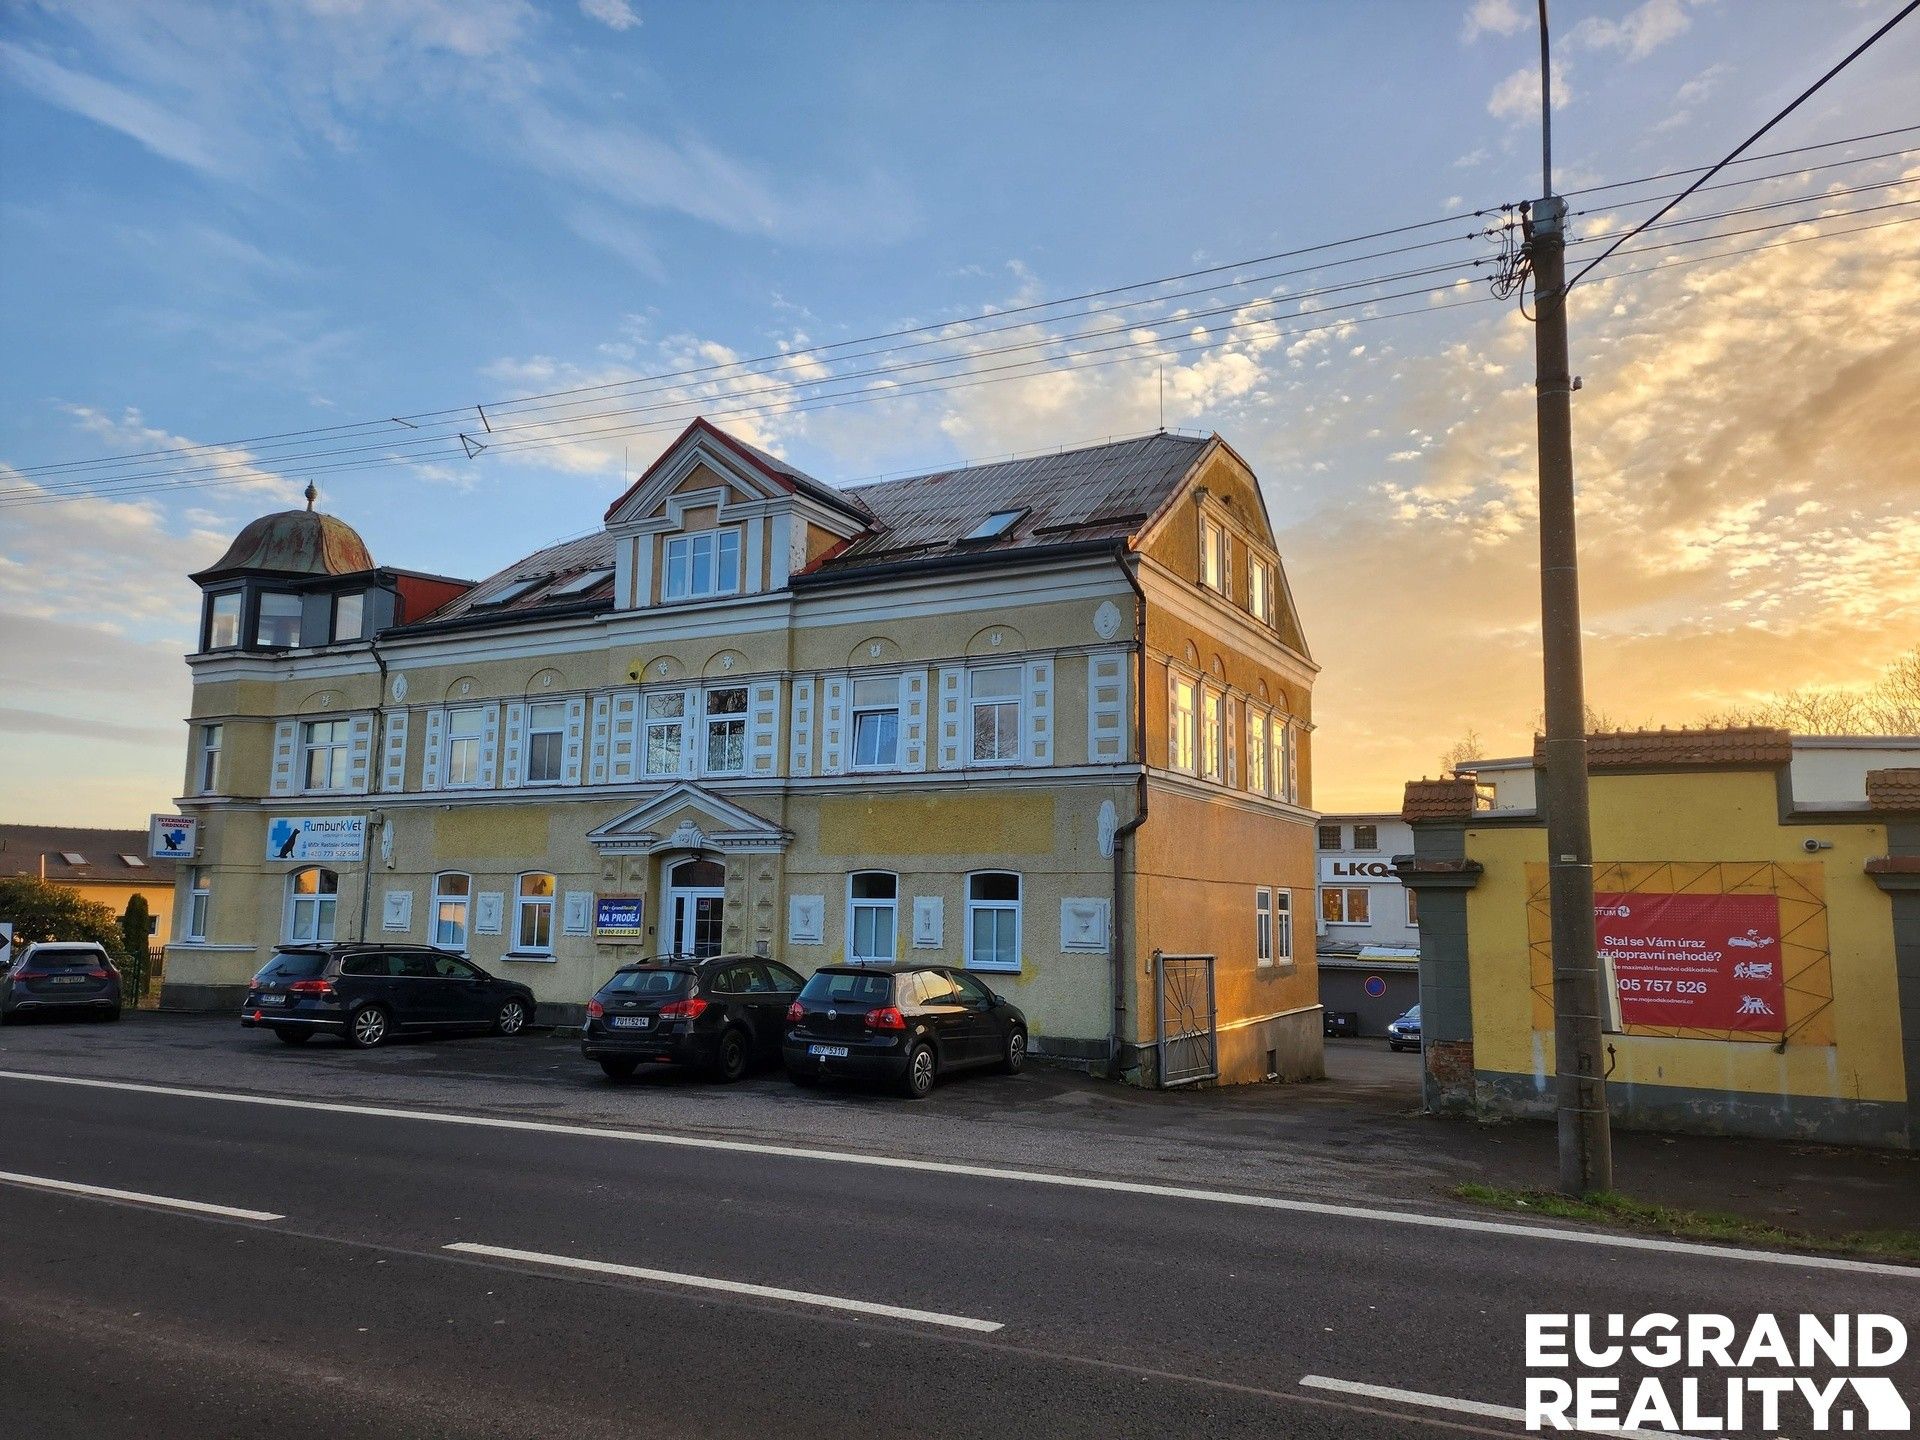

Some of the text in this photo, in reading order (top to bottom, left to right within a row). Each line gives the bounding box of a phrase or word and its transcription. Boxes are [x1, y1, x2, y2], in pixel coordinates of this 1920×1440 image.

[303, 820, 362, 832] RumburkVet
[1333, 862, 1390, 878] LKQ
[599, 913, 640, 922] NA PRODEJ
[1603, 935, 1706, 948] Stal se Vám úraz
[1611, 949, 1665, 961] dopravní
[1667, 950, 1722, 962] nehodě?
[1643, 979, 1673, 992] 757
[1676, 981, 1707, 994] 526
